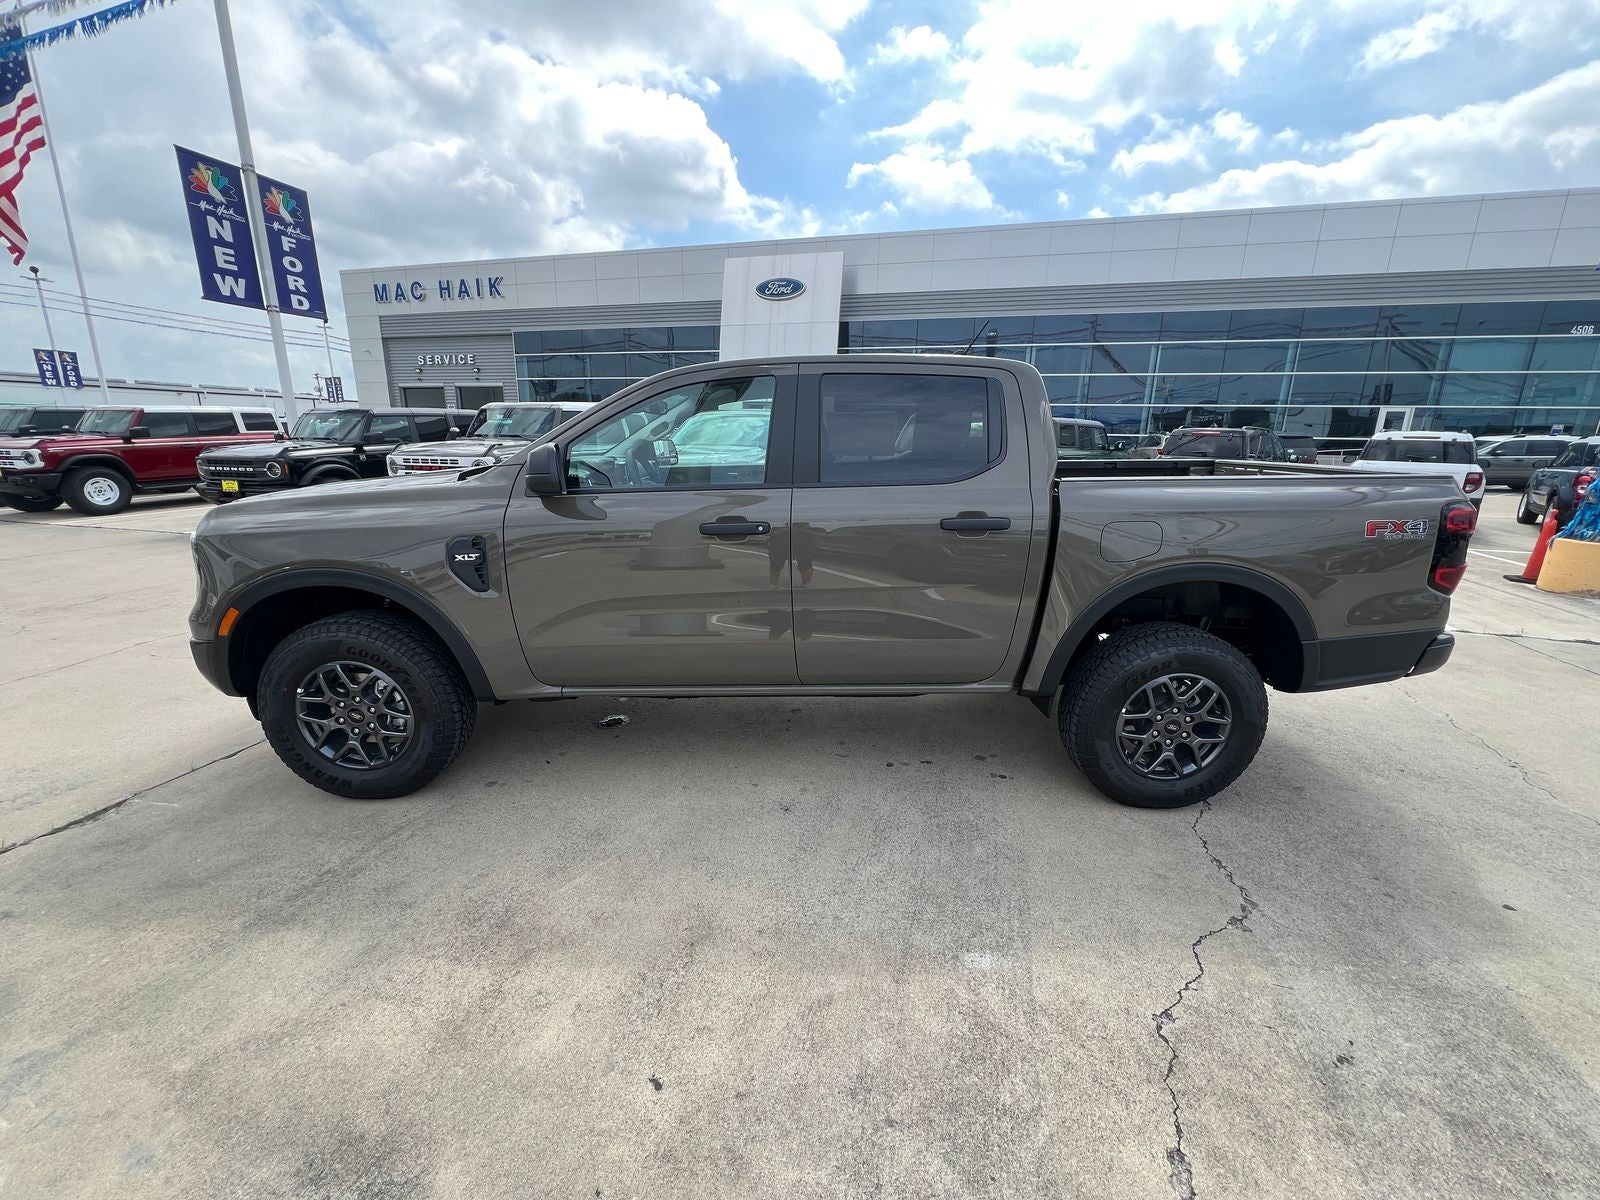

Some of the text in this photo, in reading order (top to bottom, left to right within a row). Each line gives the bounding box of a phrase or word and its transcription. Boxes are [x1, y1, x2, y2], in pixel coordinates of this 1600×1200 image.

[206, 215, 246, 299] NEW
[281, 235, 310, 310] FORD
[373, 276, 504, 303] MAC HAIK
[765, 281, 794, 295] Ford
[1570, 325, 1595, 335] 4506
[417, 354, 475, 365] SERVICE
[42, 364, 57, 386] NEW
[66, 365, 78, 387] FORD
[1364, 519, 1429, 538] FX4
[454, 553, 480, 562] XLT
